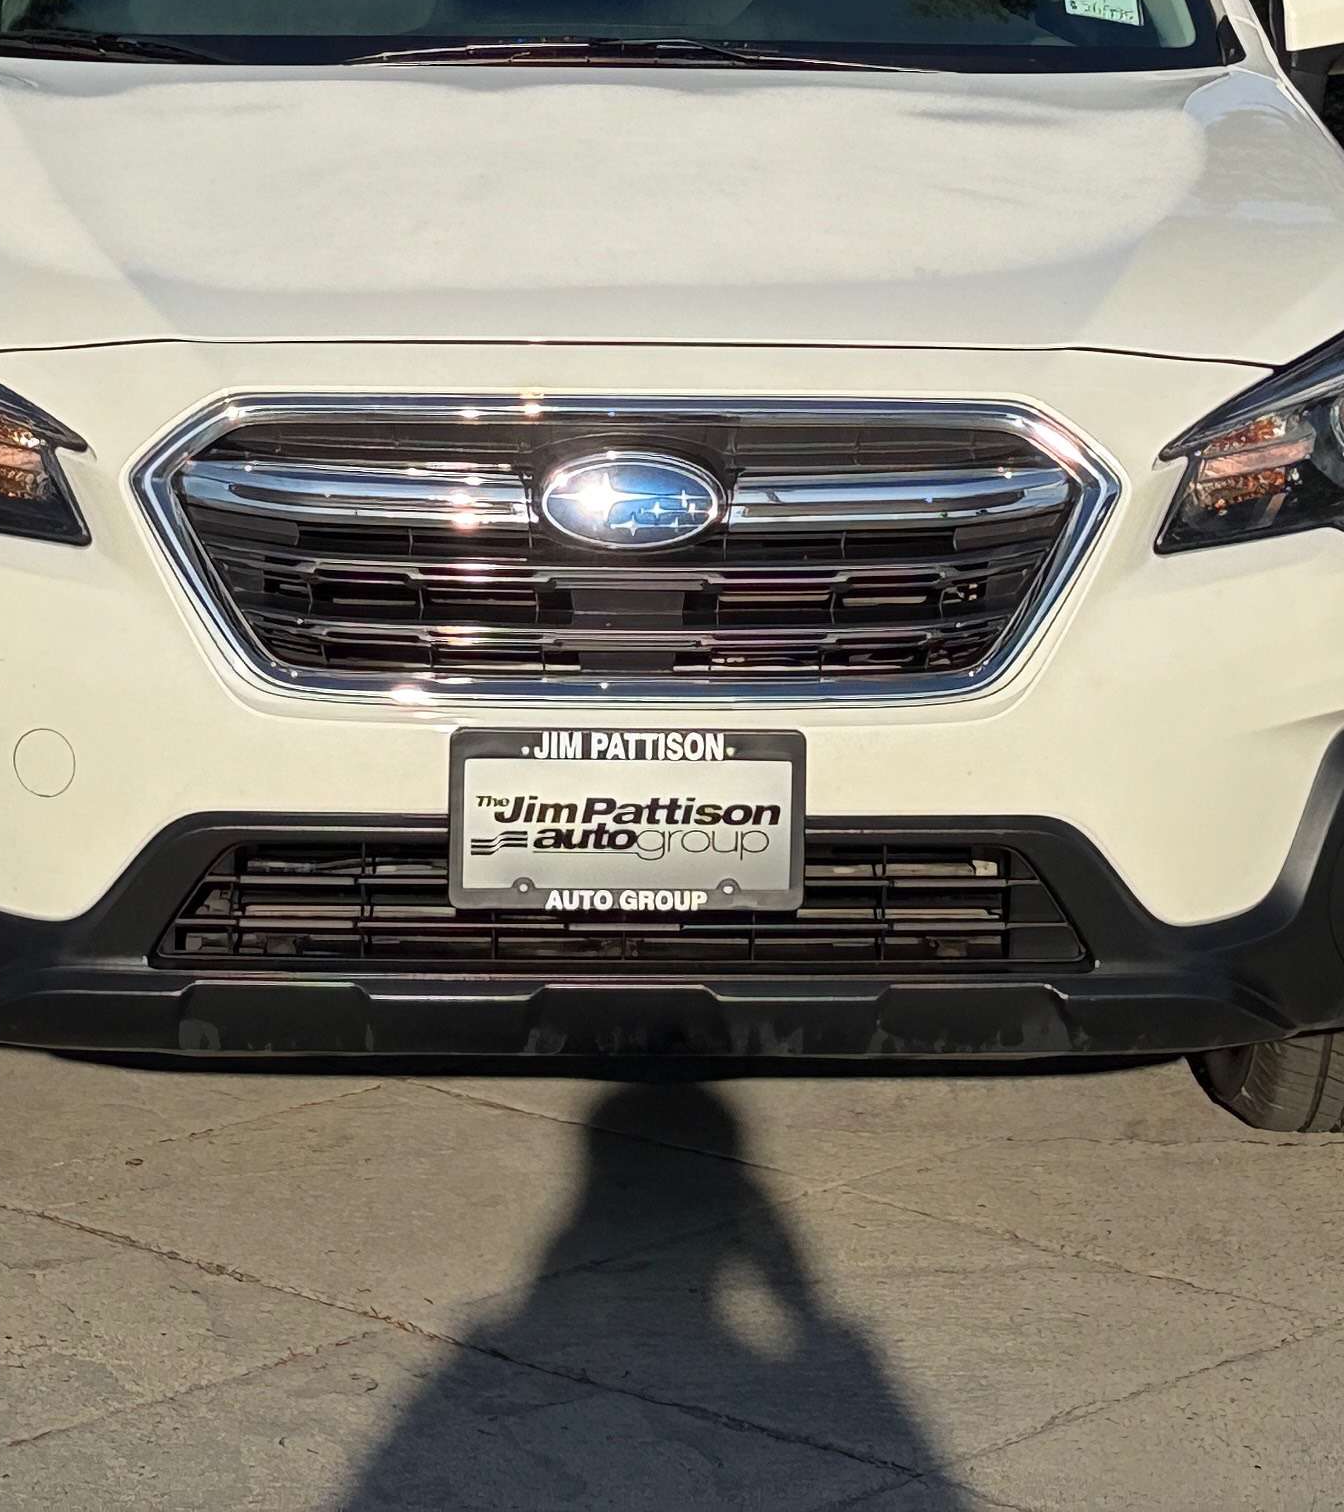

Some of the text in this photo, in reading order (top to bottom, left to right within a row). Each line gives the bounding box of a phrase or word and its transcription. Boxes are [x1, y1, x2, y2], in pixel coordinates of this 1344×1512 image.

[533, 731, 725, 761] JIM PATTISON
[475, 795, 781, 826] The Jim Pattison
[545, 889, 708, 911] AUTO GROUP
